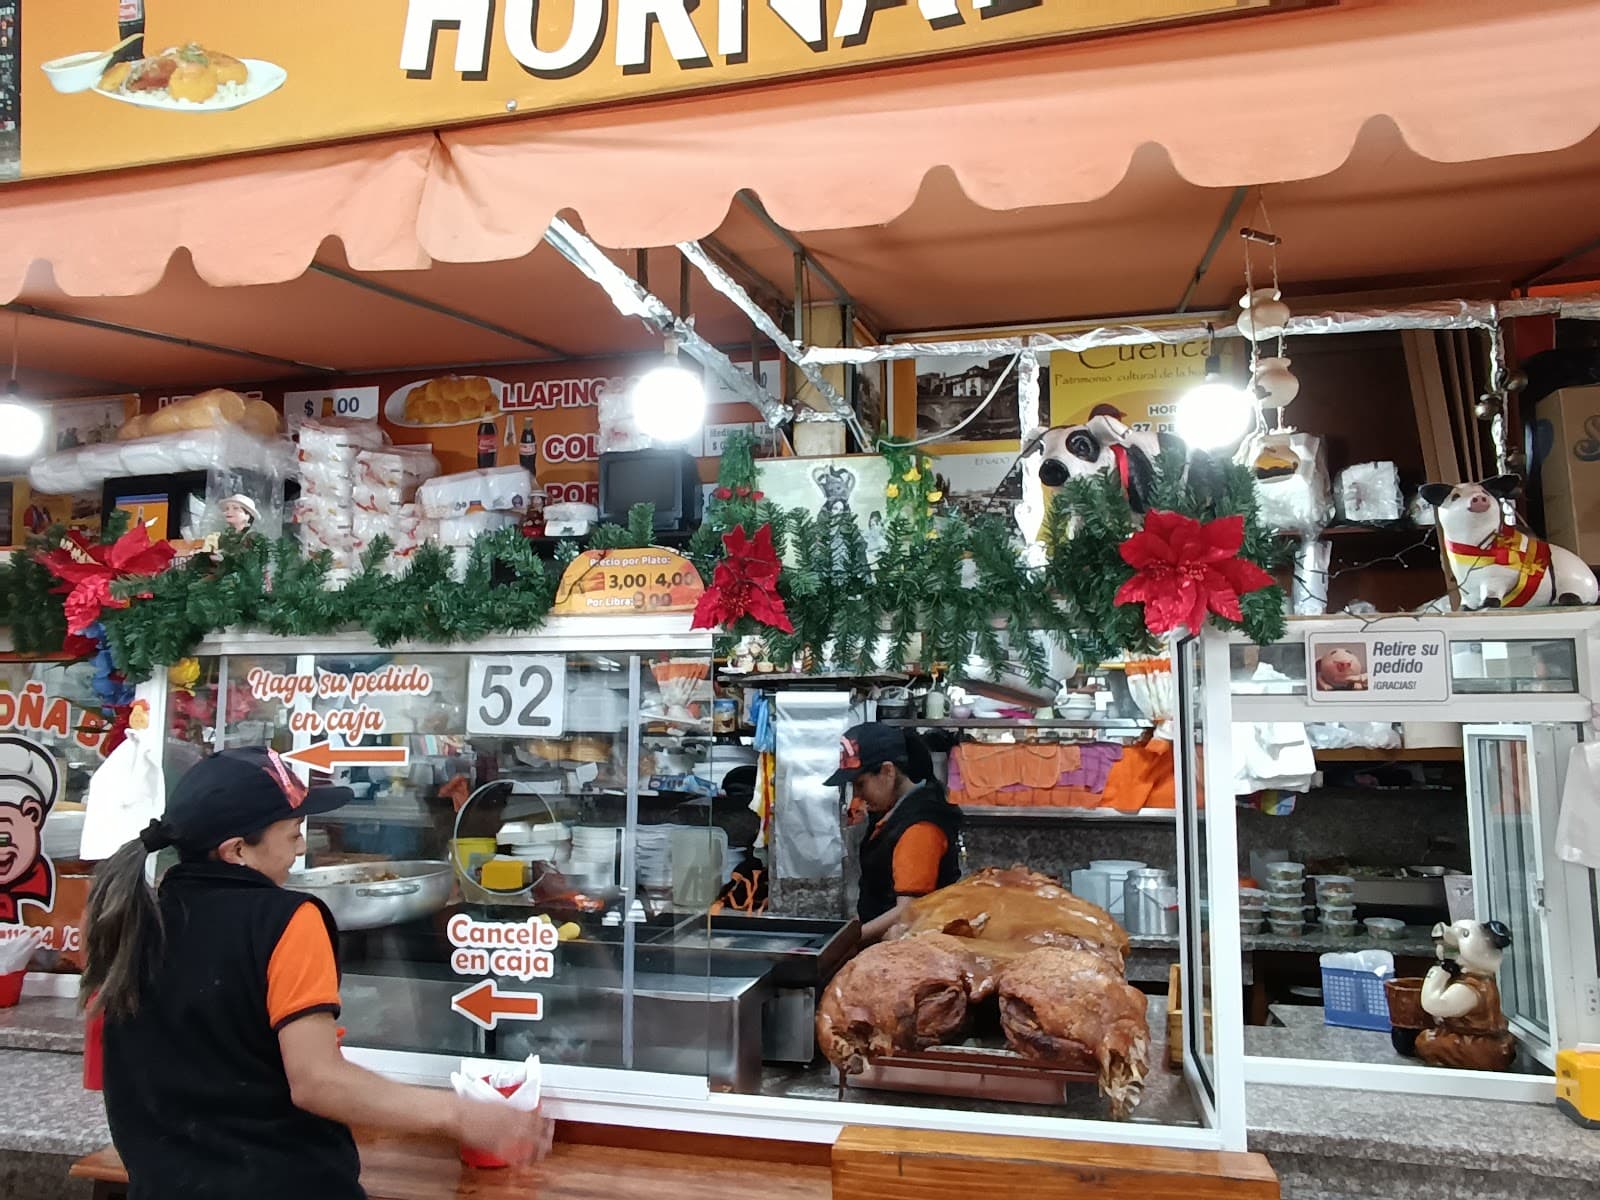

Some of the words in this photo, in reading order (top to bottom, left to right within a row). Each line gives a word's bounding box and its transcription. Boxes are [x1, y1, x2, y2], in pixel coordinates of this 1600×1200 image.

[1149, 405, 1177, 416] HOR
[545, 436, 600, 460] COL
[590, 557, 620, 567] Precio
[622, 558, 639, 568] por
[642, 555, 672, 565] Plato:
[609, 574, 647, 591] 3,00
[655, 572, 695, 589] 4,00
[606, 596, 635, 607] Libra:
[1373, 641, 1417, 656] Retire
[1421, 643, 1440, 656] su
[1373, 659, 1424, 677] pedido
[248, 667, 316, 703] Haga
[319, 672, 348, 694] su
[351, 665, 430, 701] pedido
[1373, 680, 1417, 690] ¡GRACIAS!
[479, 665, 553, 727] 52
[290, 714, 321, 734] en
[326, 707, 384, 743] caja
[451, 919, 554, 945] Cancele
[455, 952, 485, 970] en
[494, 951, 549, 976] caja
